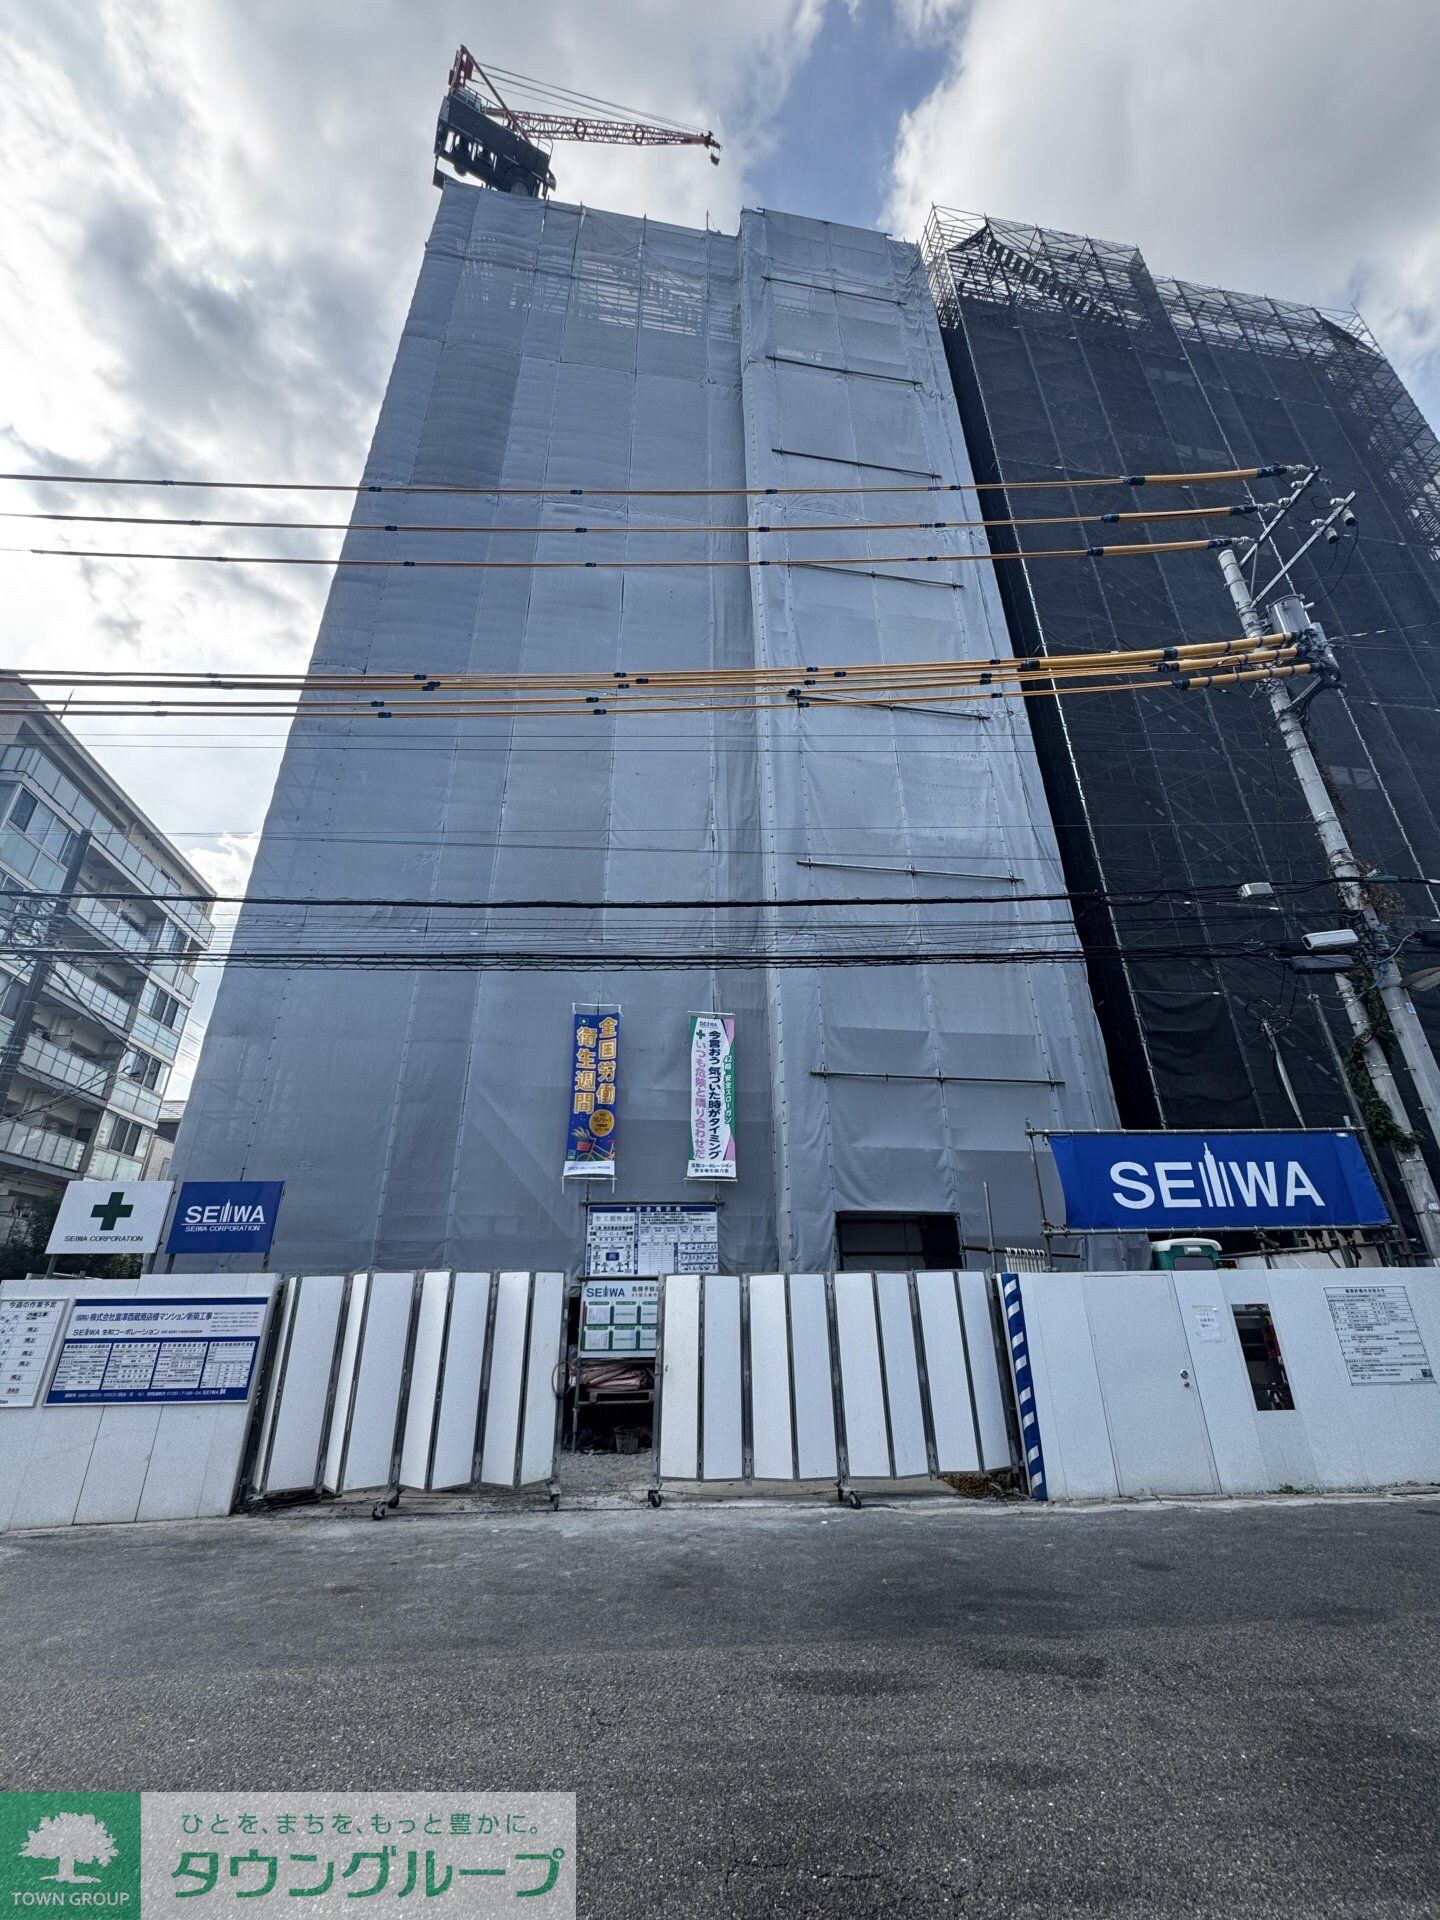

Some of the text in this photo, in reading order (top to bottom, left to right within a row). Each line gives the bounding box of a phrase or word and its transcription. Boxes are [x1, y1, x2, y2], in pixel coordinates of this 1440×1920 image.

[574, 1026, 598, 1115] 衛生週間
[596, 1017, 618, 1105] 全国労働
[1110, 1142, 1325, 1210] SEIWA
[184, 1199, 266, 1224] SEIWA
[586, 1286, 626, 1298] SEIWA
